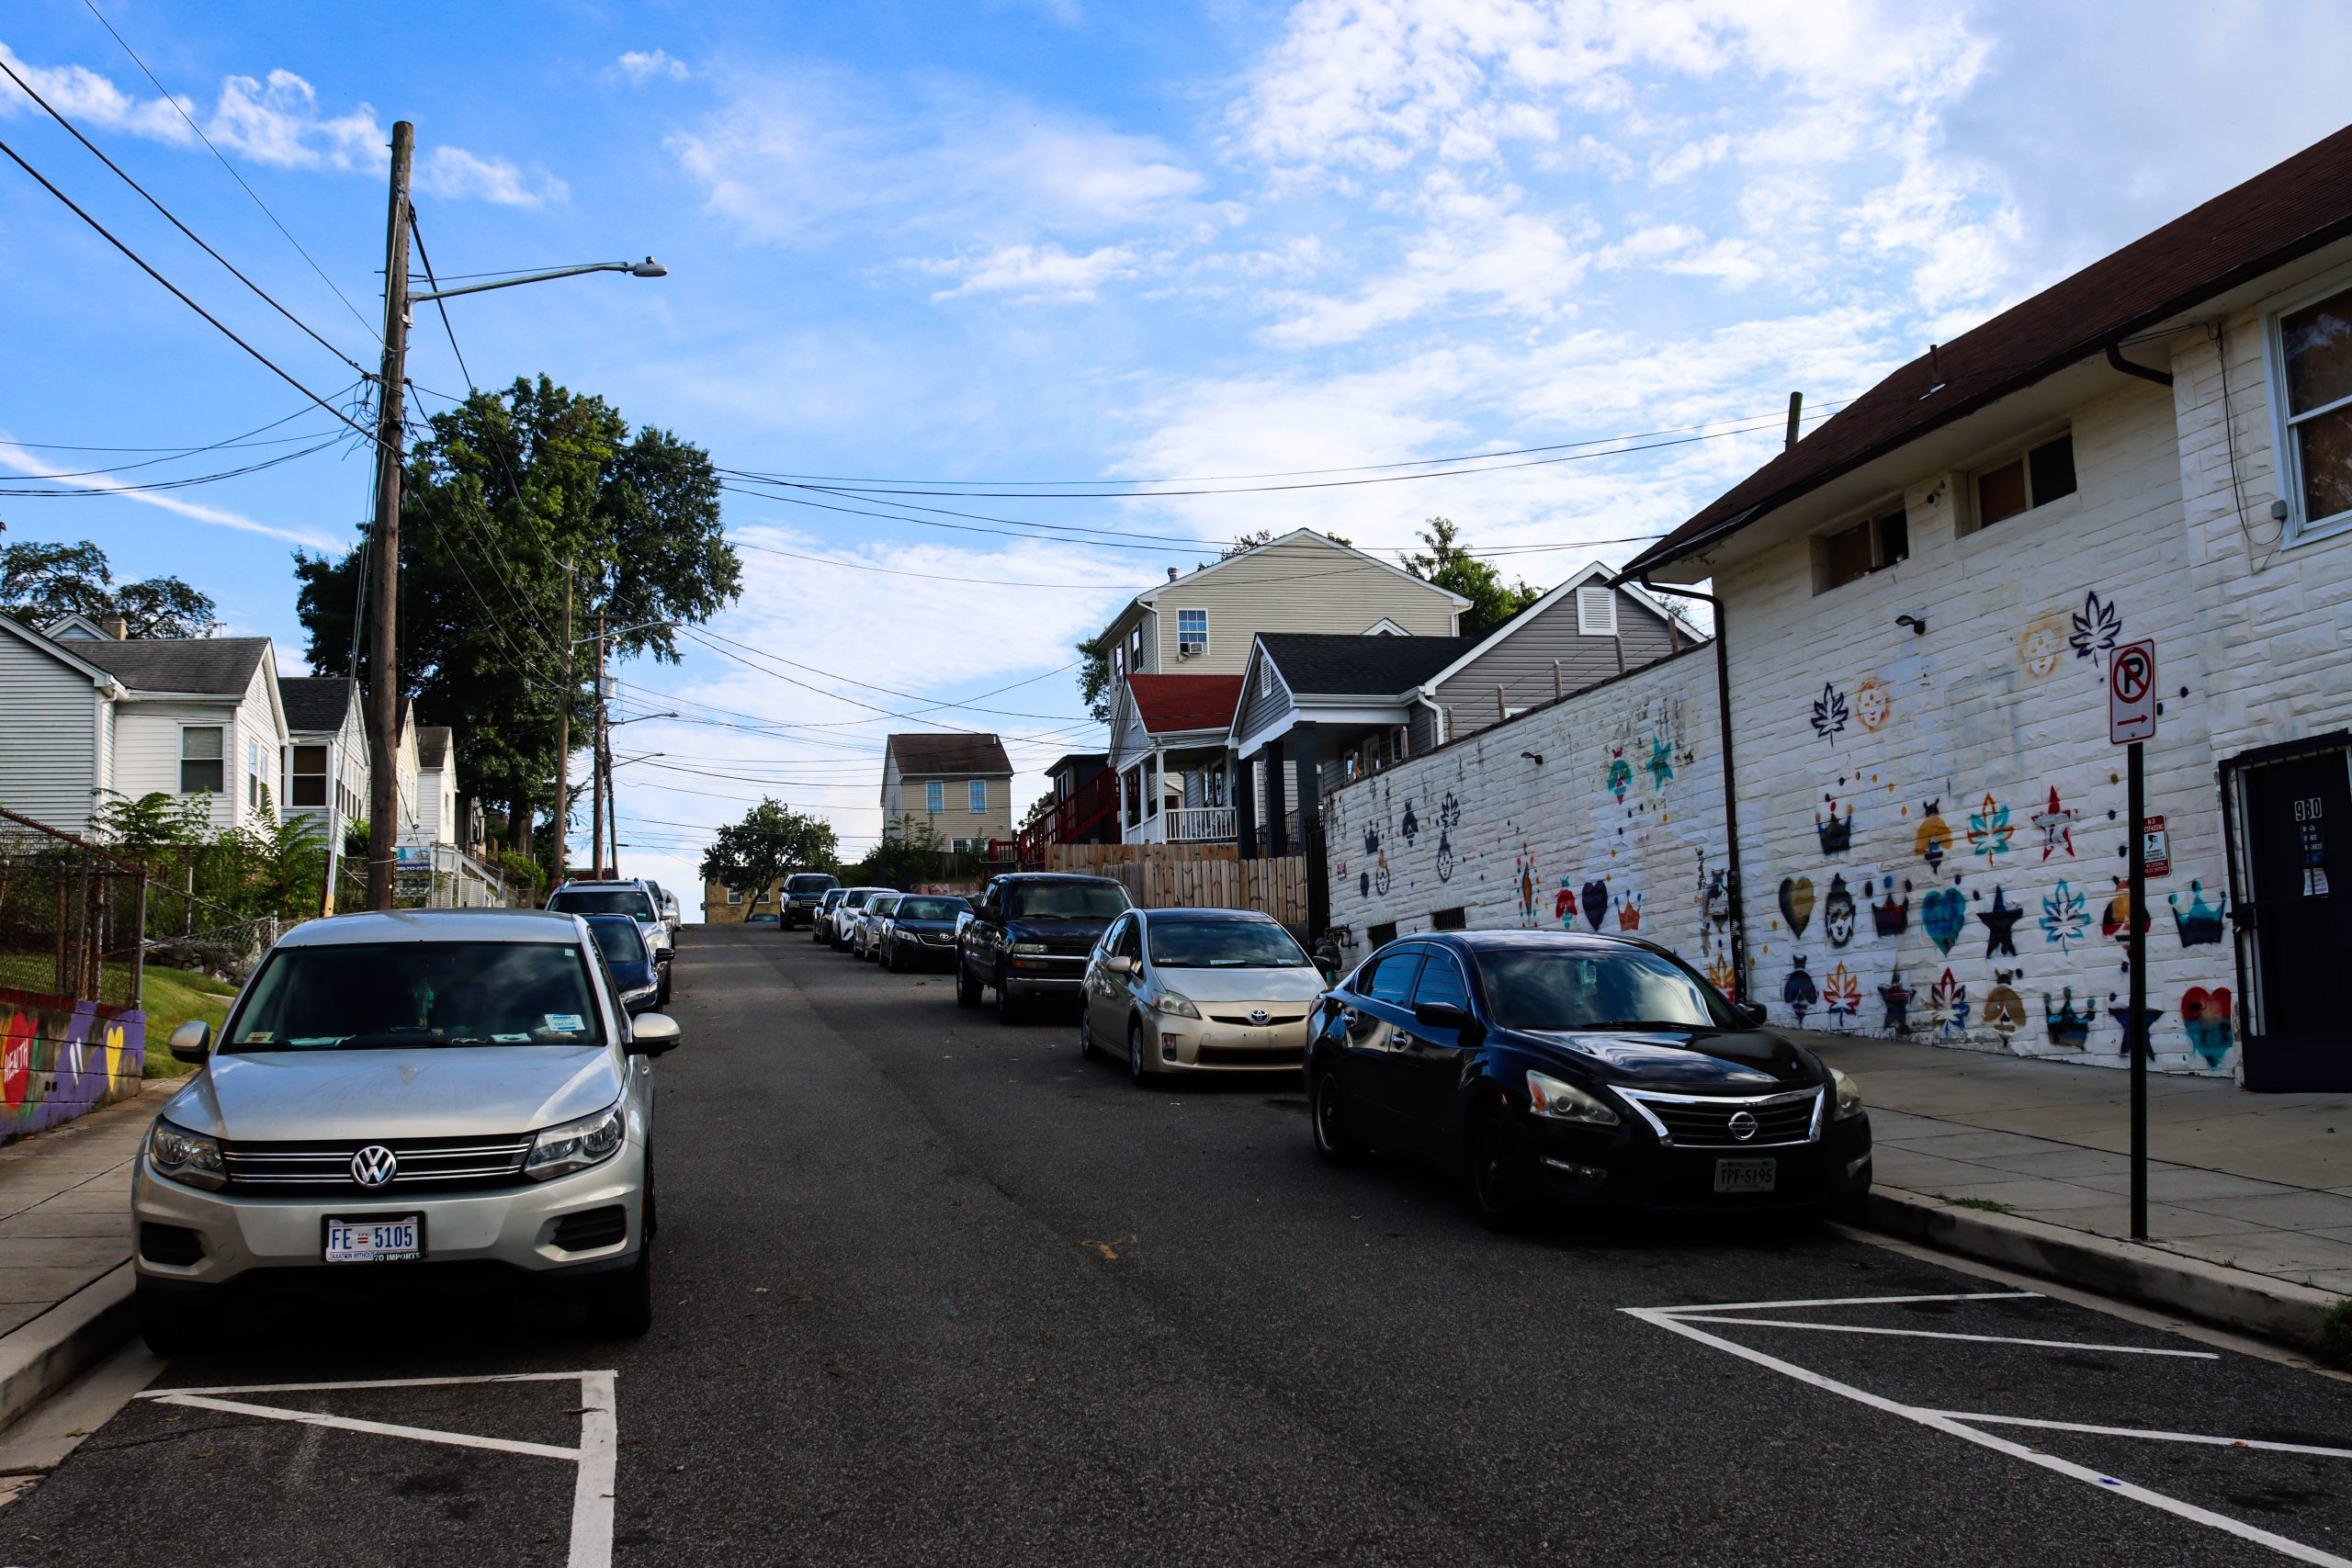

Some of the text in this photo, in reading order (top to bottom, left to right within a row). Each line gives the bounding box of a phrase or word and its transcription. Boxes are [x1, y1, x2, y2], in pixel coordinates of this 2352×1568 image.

[2143, 823, 2165, 833] ESPASSING
[4, 1037, 28, 1083] HEALTH
[332, 1225, 413, 1250] FE 5105
[386, 1252, 422, 1261] IMPORTS
